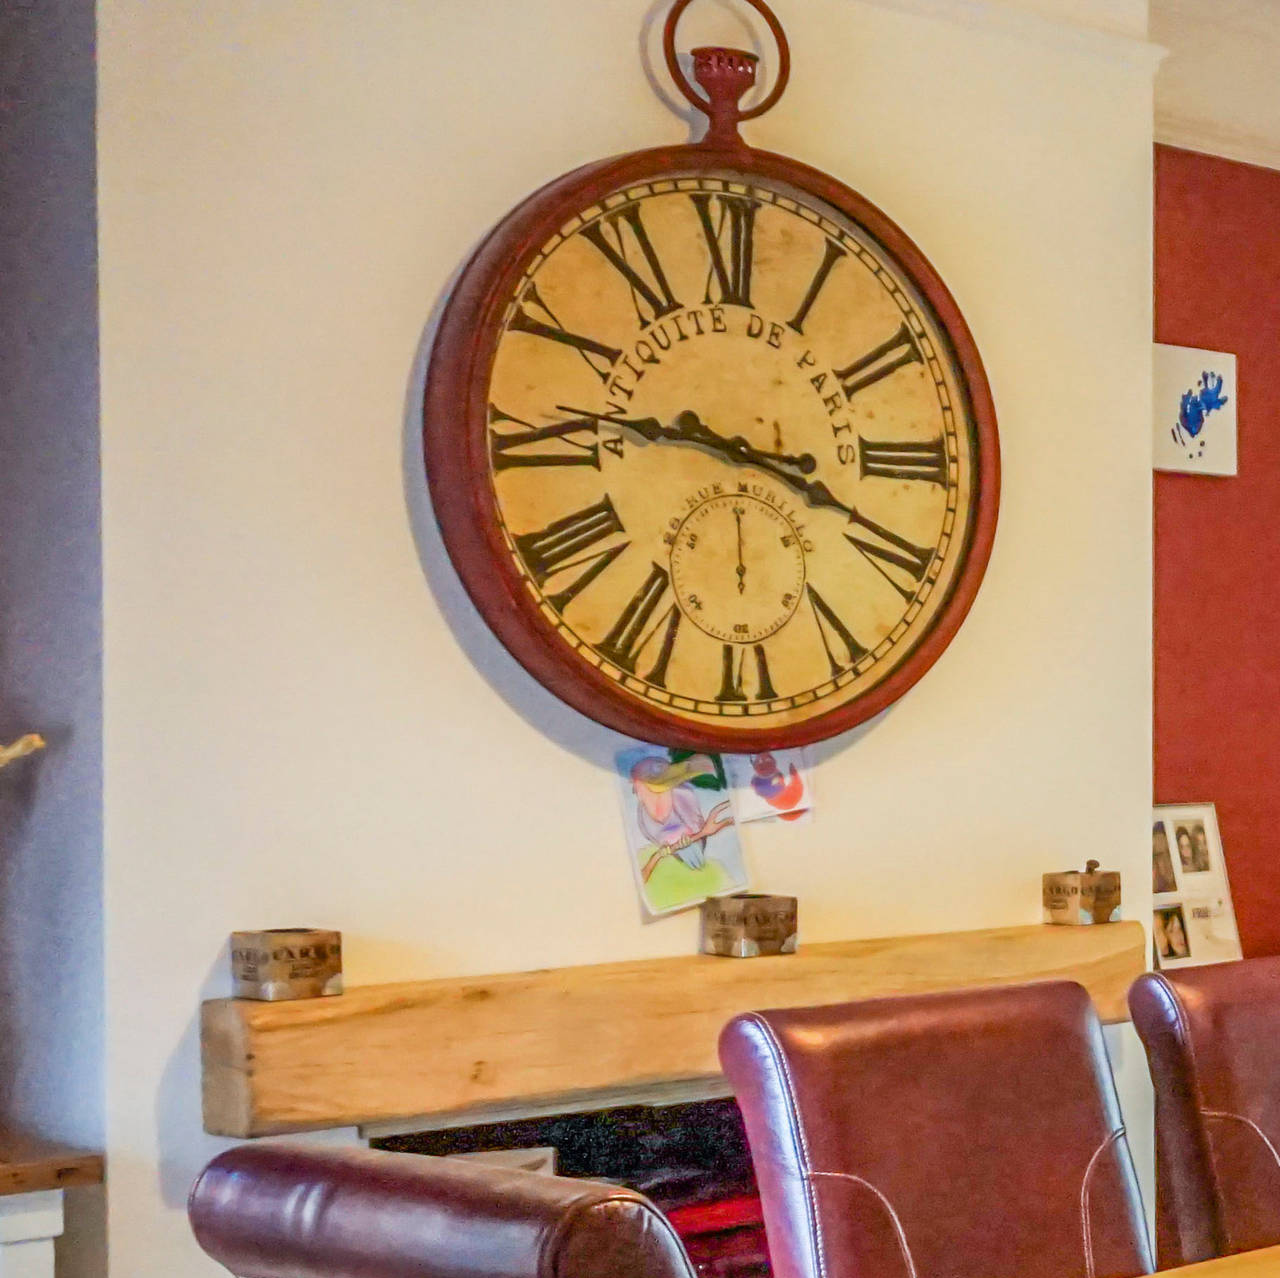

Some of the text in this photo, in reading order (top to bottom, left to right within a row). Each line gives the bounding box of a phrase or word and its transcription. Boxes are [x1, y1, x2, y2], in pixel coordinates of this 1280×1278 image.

[579, 201, 685, 330] XI
[689, 192, 763, 310] XII
[786, 236, 848, 336] I
[507, 281, 624, 385] X
[831, 321, 925, 401] II
[488, 402, 601, 476] IX
[746, 313, 786, 349] DE
[796, 350, 856, 466] PARIS
[858, 435, 949, 490] III
[512, 493, 632, 616] VIII
[843, 505, 938, 605] IV
[806, 582, 871, 679] V
